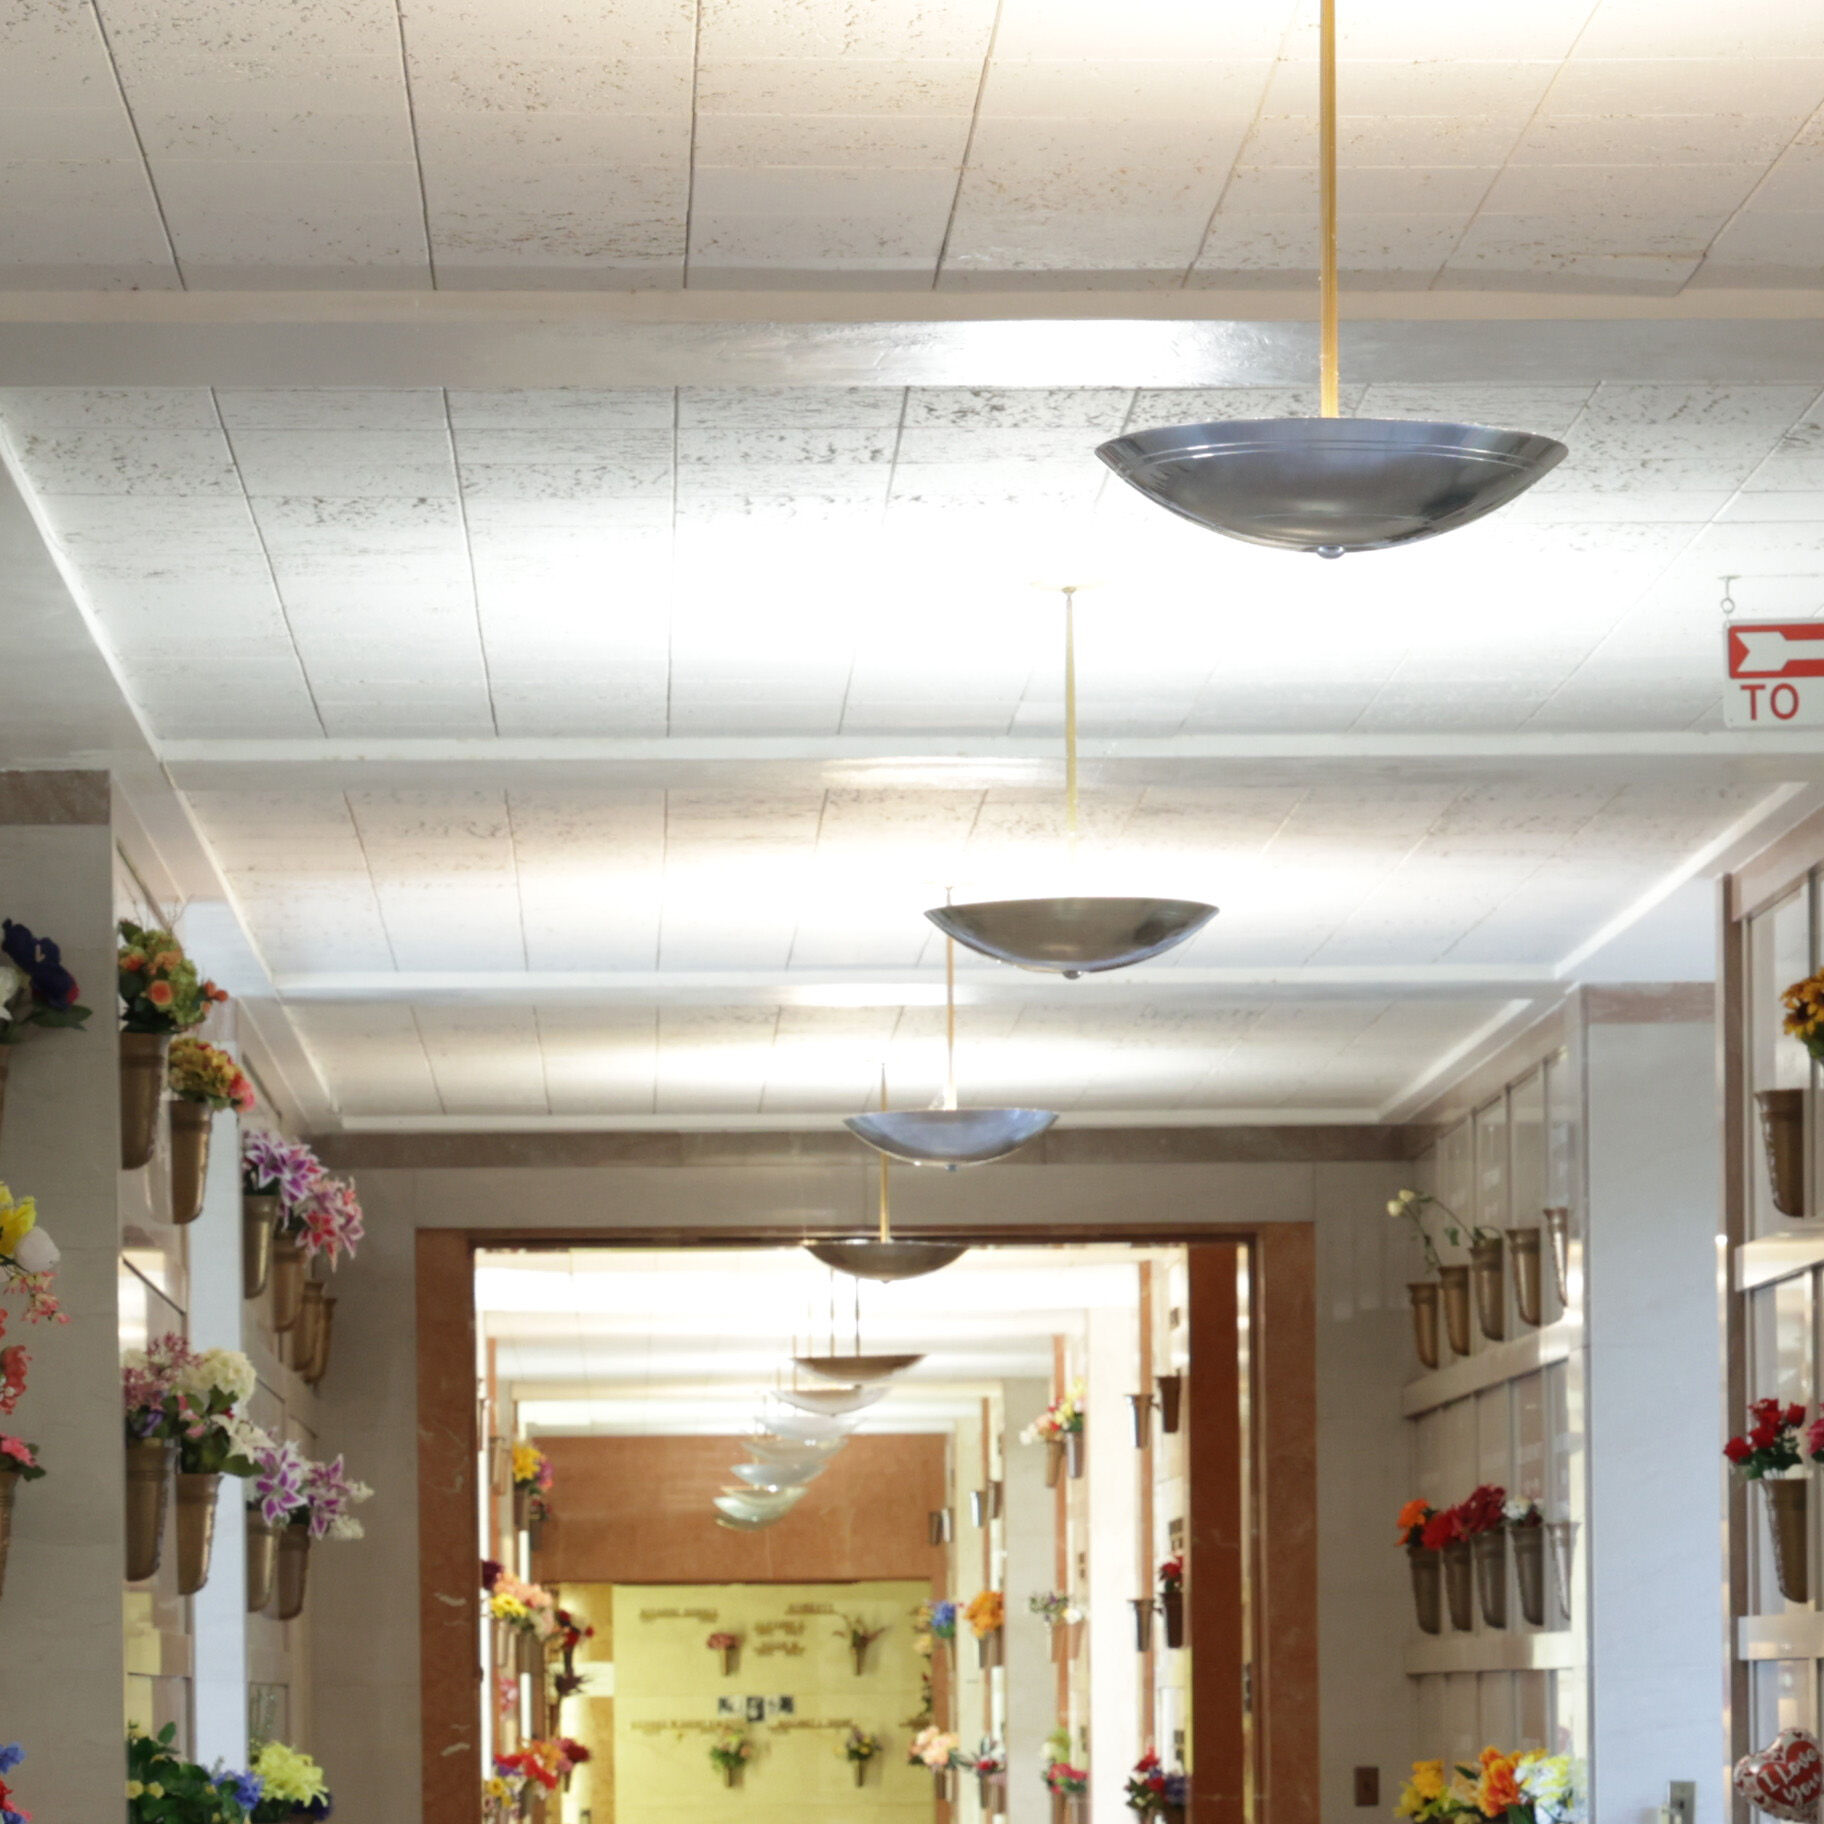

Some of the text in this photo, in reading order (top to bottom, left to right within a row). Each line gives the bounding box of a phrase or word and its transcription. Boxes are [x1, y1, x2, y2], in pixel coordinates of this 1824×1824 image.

[1739, 682, 1799, 721] TO
[1757, 1747, 1818, 1793] I Love
